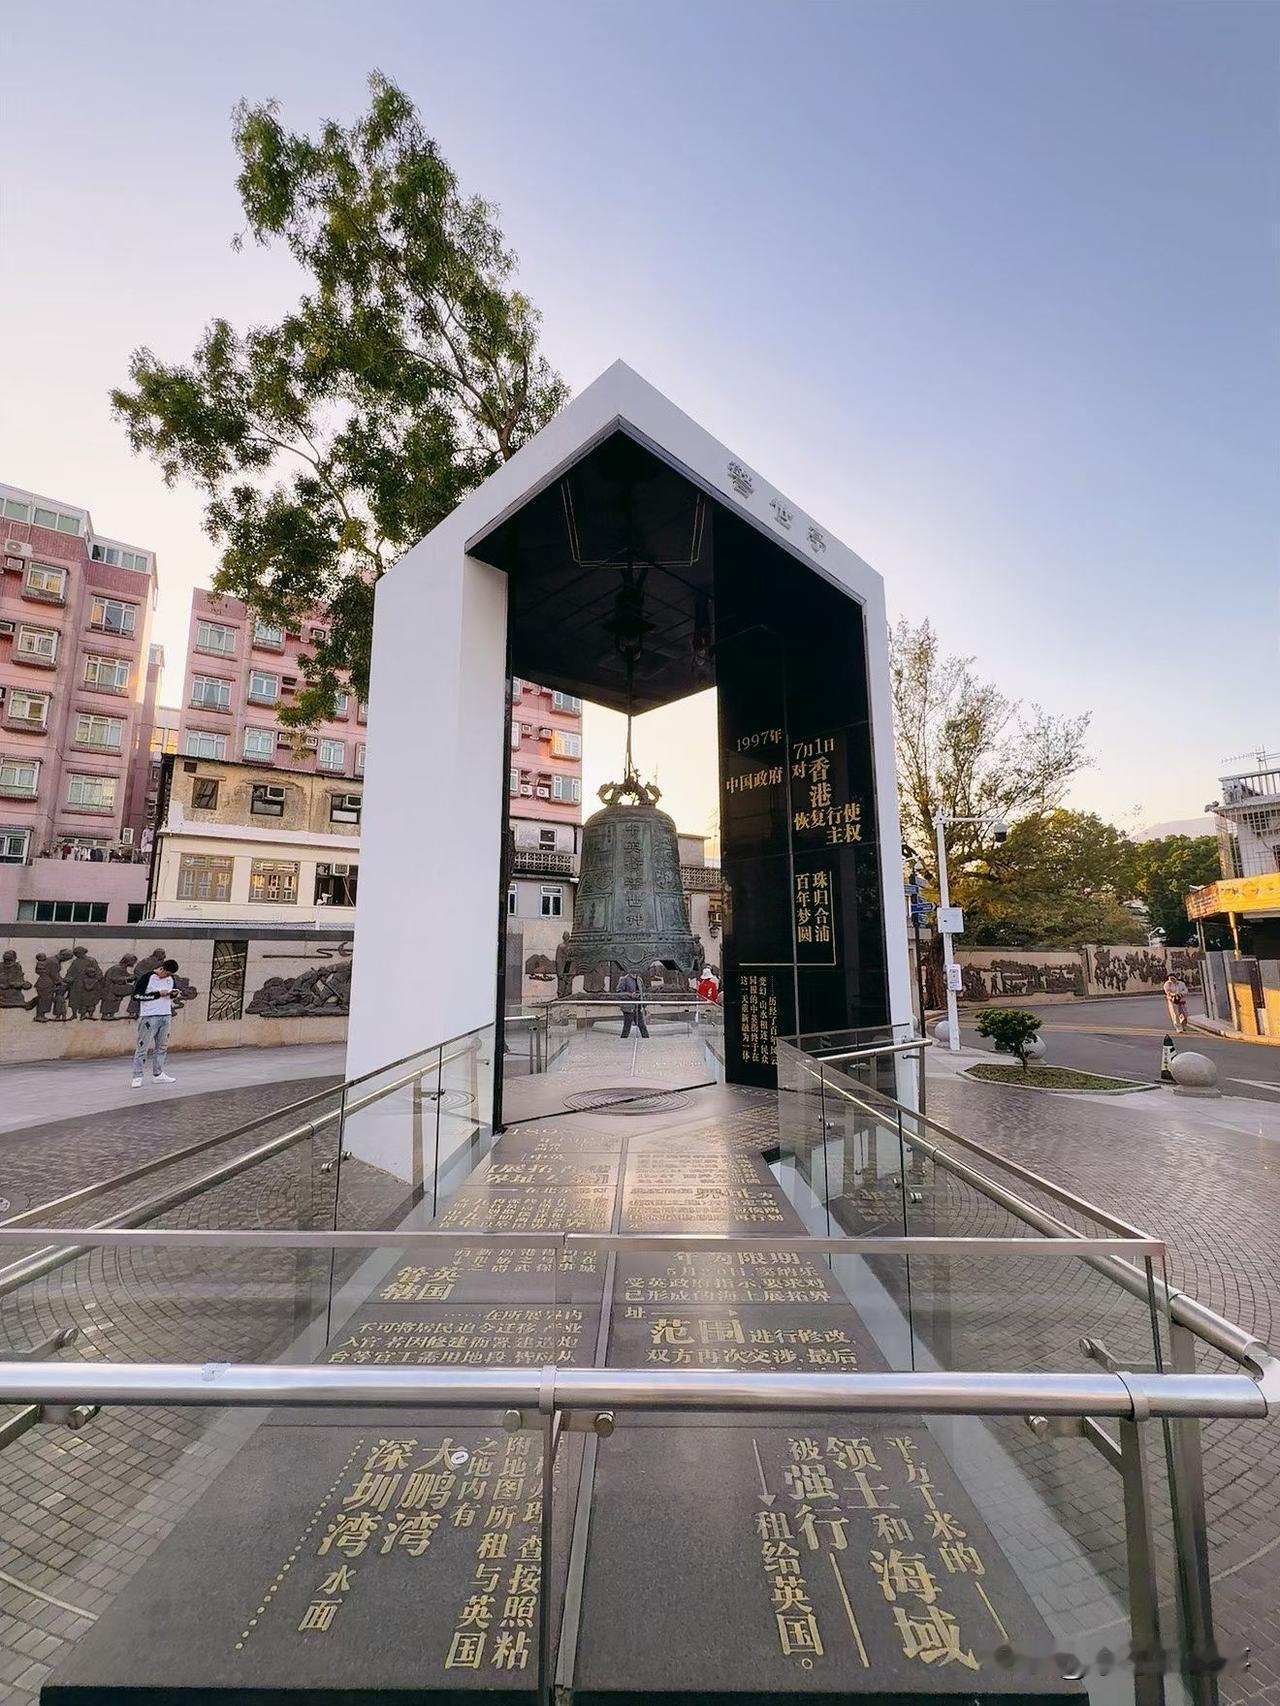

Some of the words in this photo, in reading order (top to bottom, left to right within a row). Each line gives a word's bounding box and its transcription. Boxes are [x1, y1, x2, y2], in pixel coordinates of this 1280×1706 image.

[736, 729, 783, 752] 1997年
[793, 738, 835, 760] 7月1日
[726, 766, 784, 794] 中国政府
[792, 761, 808, 780] 对
[809, 756, 832, 808] 香港
[794, 803, 862, 831] 恢复行使
[826, 824, 862, 845] 主权
[795, 873, 813, 943] 百年梦圆
[812, 871, 830, 942] 珠归合浦
[380, 1438, 467, 1557] 大鹏湾
[450, 1437, 498, 1528] 之地内有
[784, 1436, 850, 1550] 被强行
[884, 1436, 985, 1575] 平方千米的
[444, 1436, 532, 1670] 附地图所租与英国
[826, 1437, 981, 1670] 领土和海域
